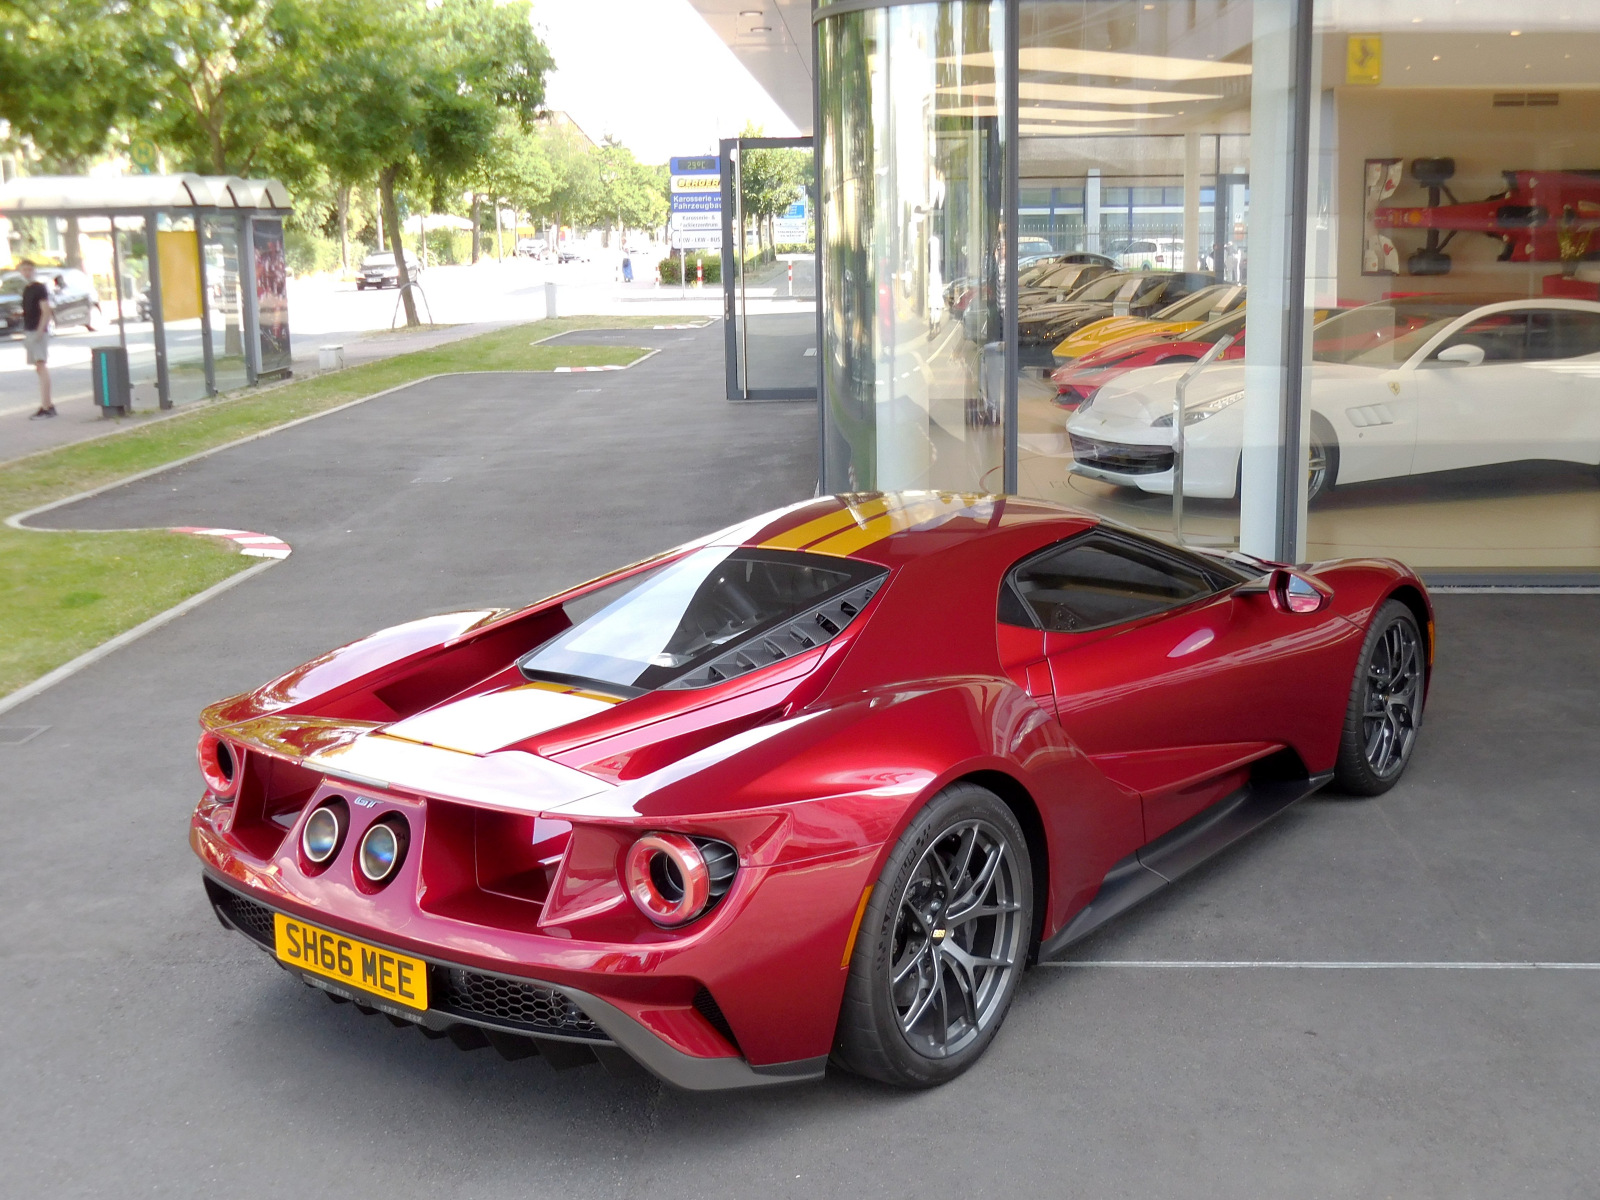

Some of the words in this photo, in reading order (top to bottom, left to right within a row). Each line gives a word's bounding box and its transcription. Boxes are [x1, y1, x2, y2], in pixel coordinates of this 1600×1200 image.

[673, 195, 712, 203] Karosserie
[286, 922, 353, 977] SH66
[361, 947, 415, 1000] MEE
